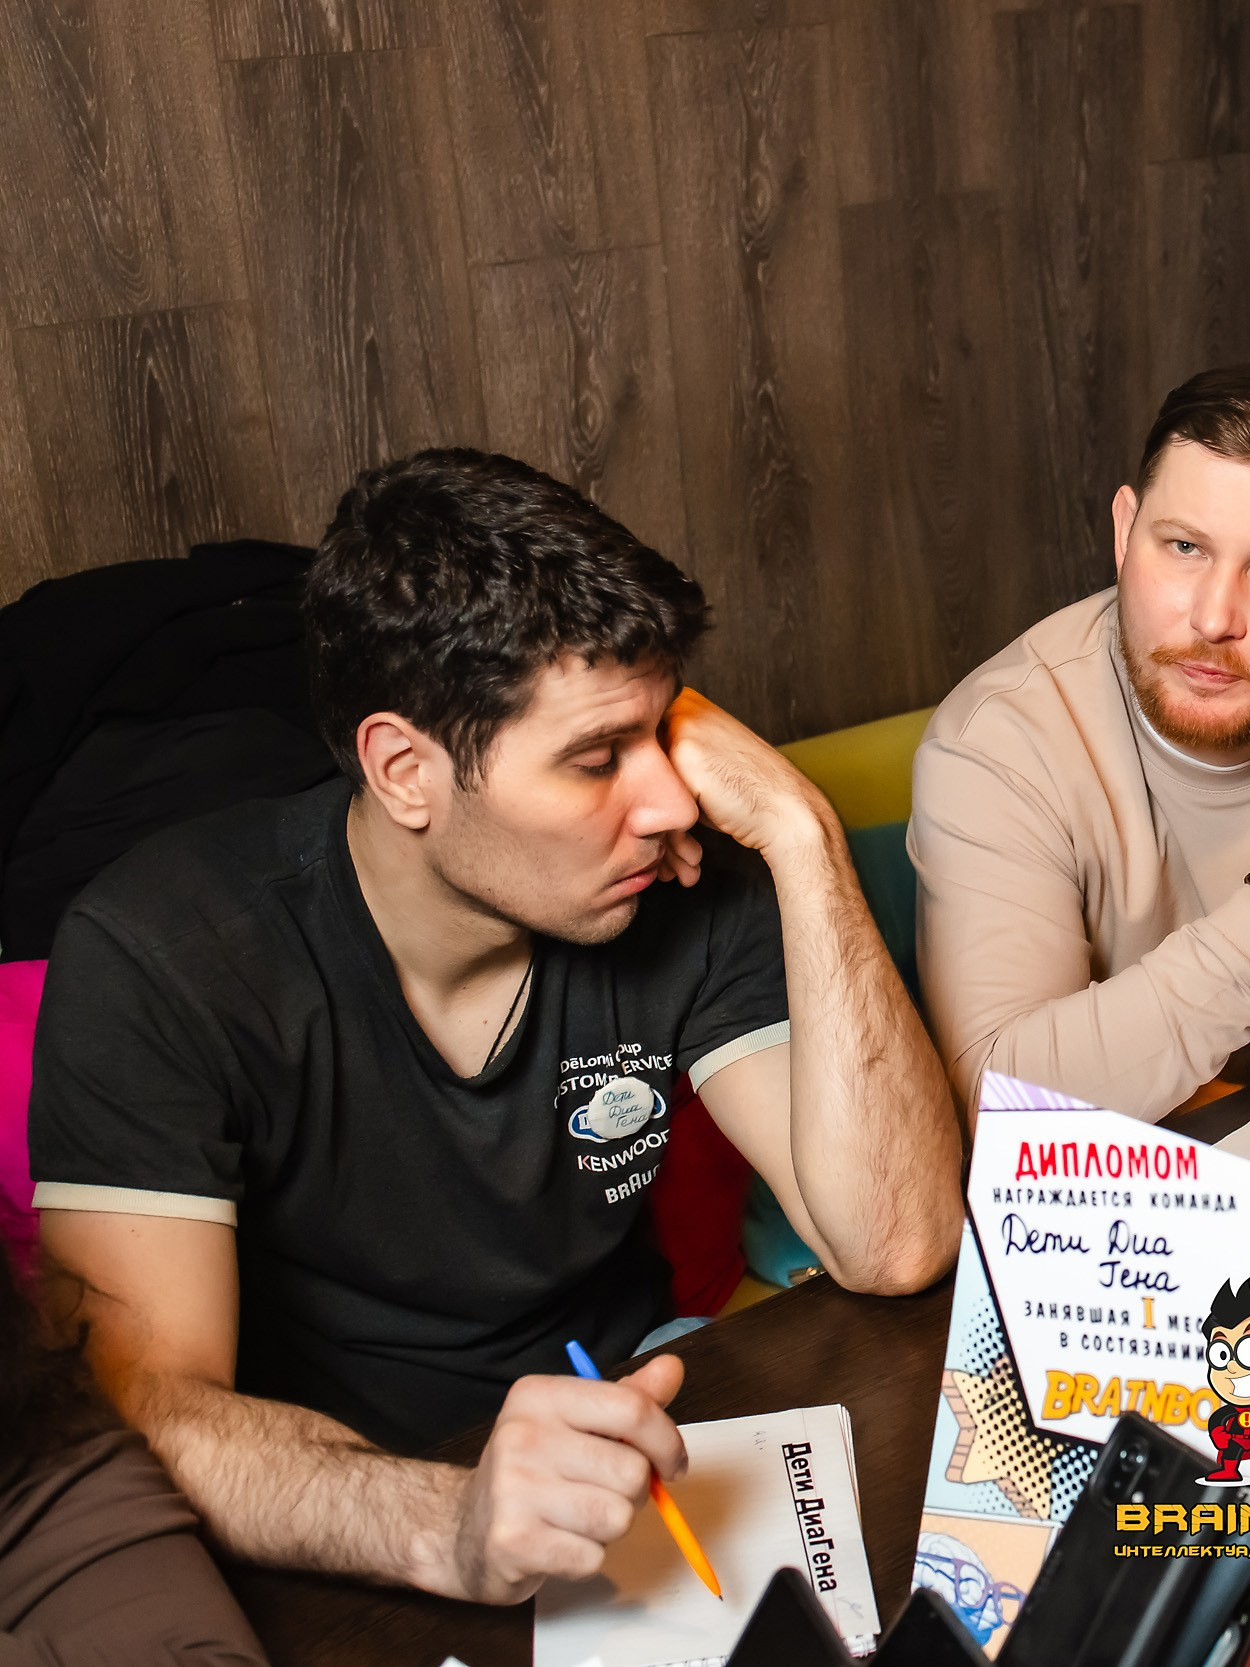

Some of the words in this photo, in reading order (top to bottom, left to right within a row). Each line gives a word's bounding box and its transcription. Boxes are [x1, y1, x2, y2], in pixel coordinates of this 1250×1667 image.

[621, 1054, 673, 1076] ERVICE
[1015, 1141, 1199, 1181] ДИПЛОМОМ
[993, 1187, 1132, 1208] НАГРАЖДАЕТСЯ
[1150, 1192, 1238, 1212] КОМАНДА
[1001, 1213, 1090, 1255] Дети
[1108, 1219, 1174, 1256] Диа
[1024, 1300, 1131, 1326] ЗАНЯВШАЯ
[1167, 1315, 1203, 1333] МЕС
[1081, 1333, 1205, 1362] СОСТЯЗАНИИ
[1041, 1370, 1222, 1431] BRAINBO
[783, 1442, 815, 1492] Дети
[795, 1498, 838, 1592] ДиаГена
